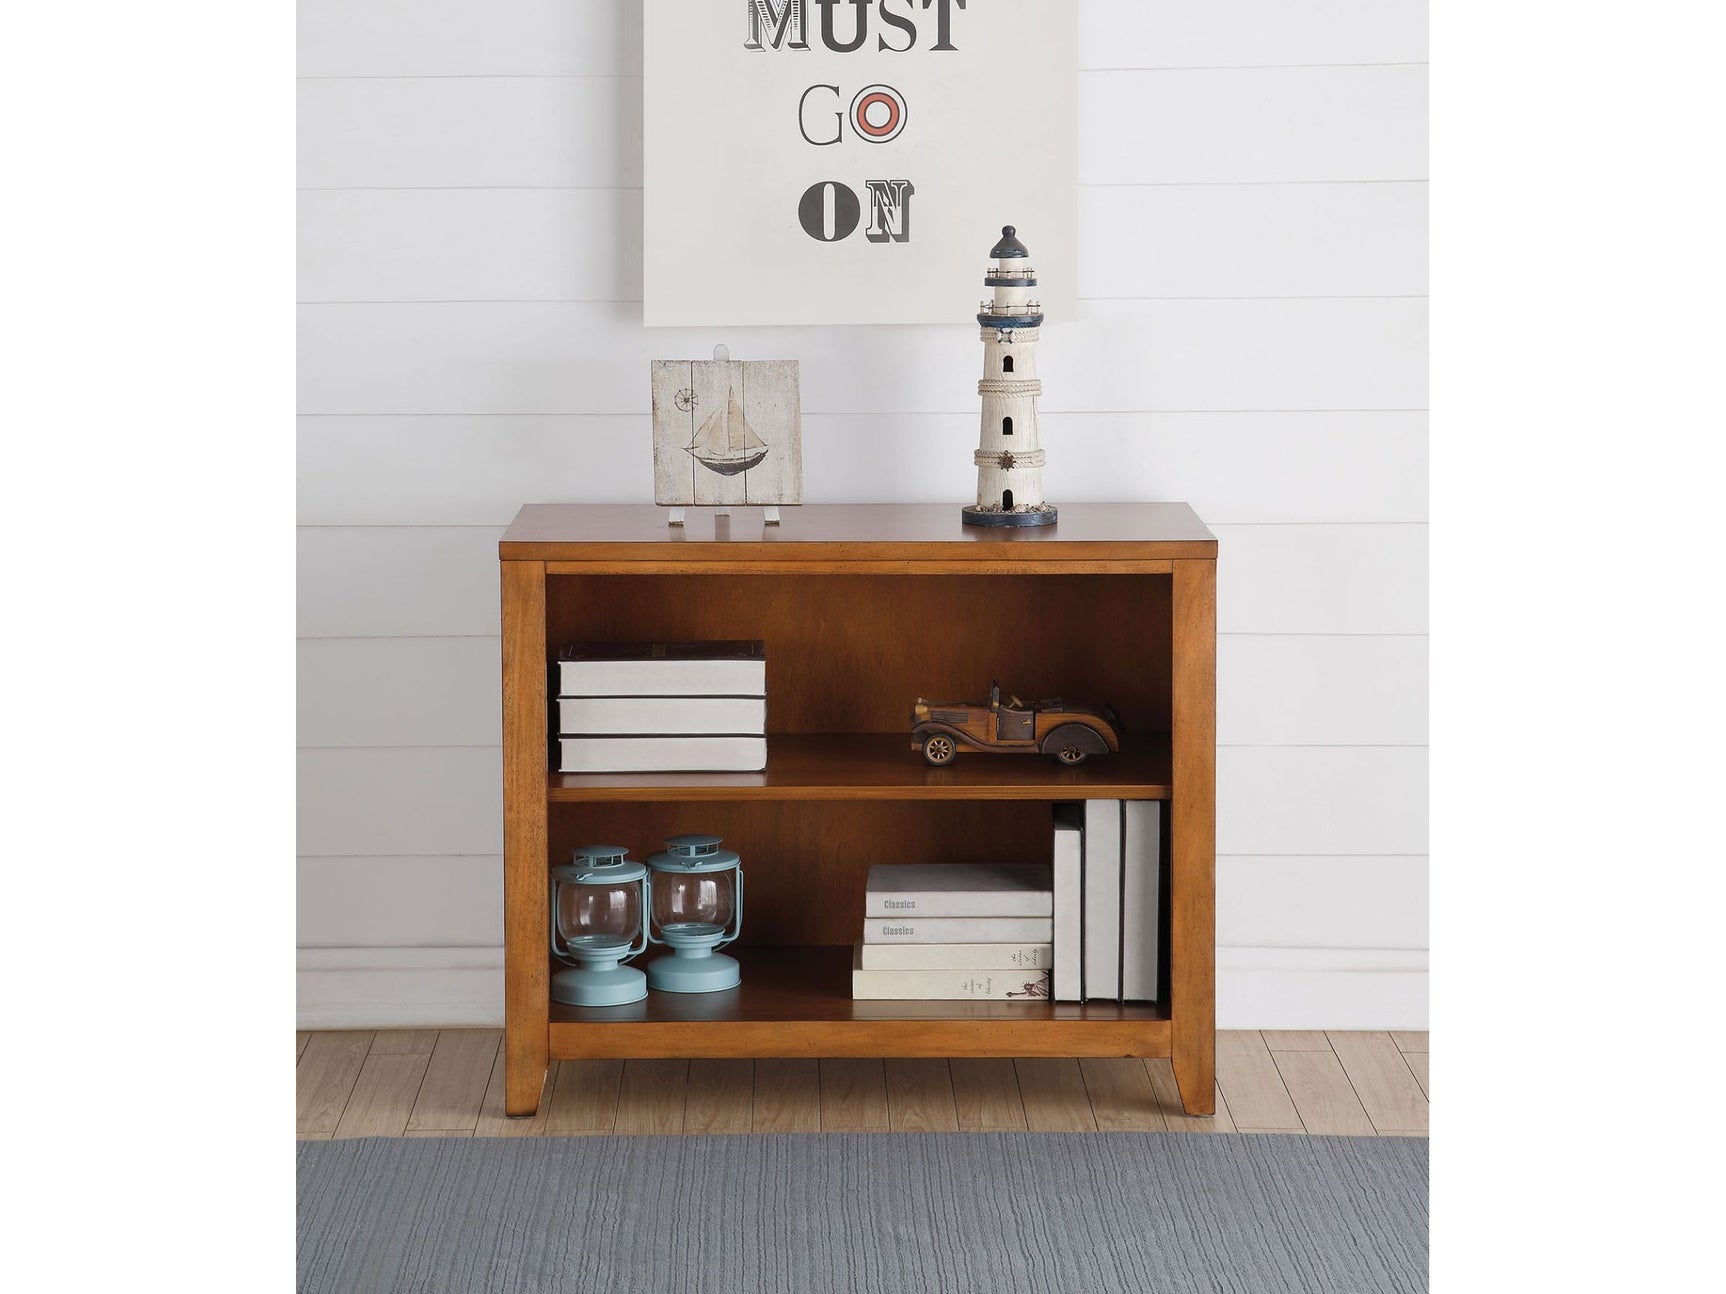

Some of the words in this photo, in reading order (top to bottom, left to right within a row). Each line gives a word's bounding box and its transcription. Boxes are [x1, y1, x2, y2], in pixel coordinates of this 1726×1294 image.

[743, 0, 966, 53] MUST
[798, 83, 908, 146] GO
[798, 180, 914, 243] ON
[884, 899, 916, 909] Classics
[882, 926, 914, 936] Classics
